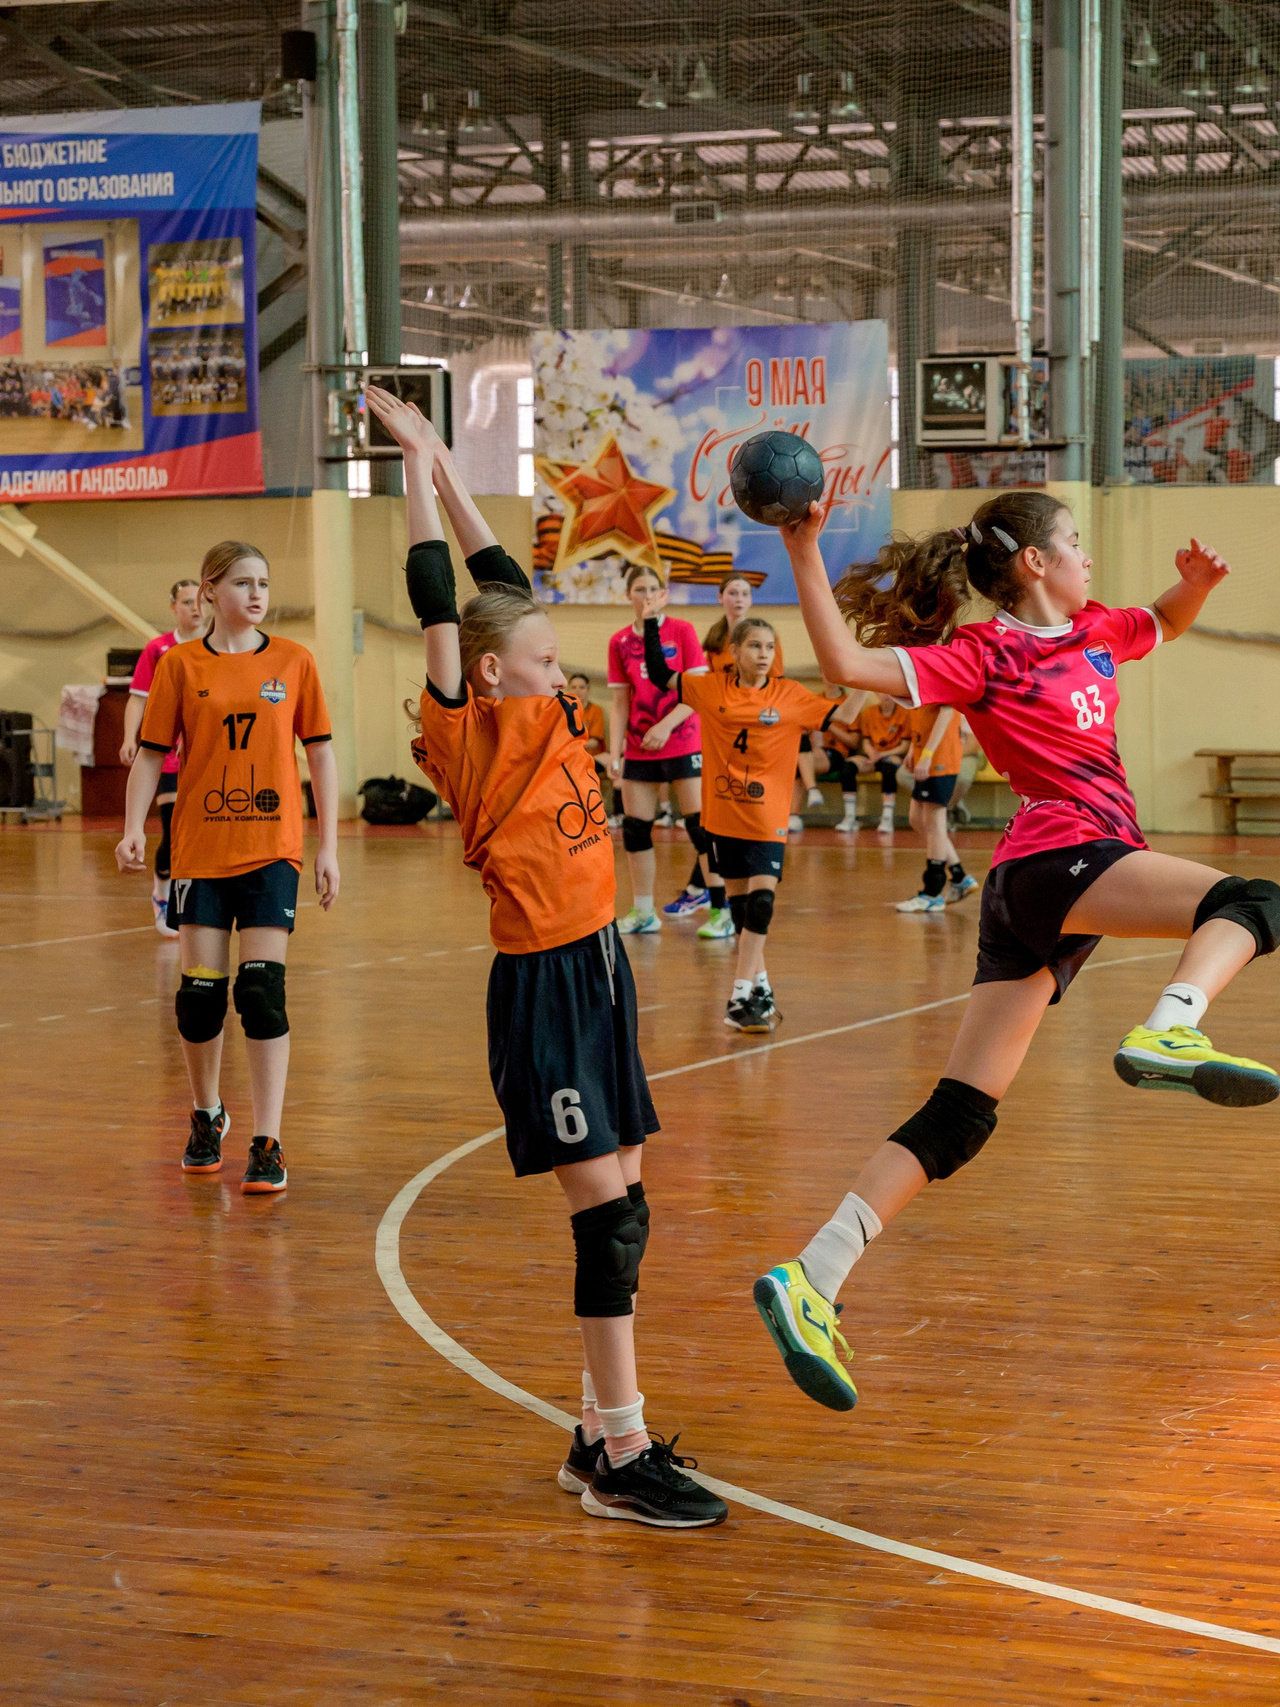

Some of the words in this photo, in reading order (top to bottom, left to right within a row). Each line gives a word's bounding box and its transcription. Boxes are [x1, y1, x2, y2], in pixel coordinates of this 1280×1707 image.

[3, 138, 107, 170] БЮДЖЕТНОЕ
[57, 172, 174, 203] ОБРАЗОВАНИЯ
[746, 359, 763, 407] 9
[770, 356, 827, 406] МАЯ
[0, 469, 67, 497] АДЕМИЯ
[71, 466, 168, 495] ГАНДБОЛА»
[1070, 684, 1106, 730] 83
[223, 712, 257, 750] 17
[733, 728, 748, 754] 4
[203, 763, 280, 814] delo
[568, 833, 601, 857] ГРУППА
[174, 878, 192, 914] 17
[550, 1087, 588, 1144] 6
